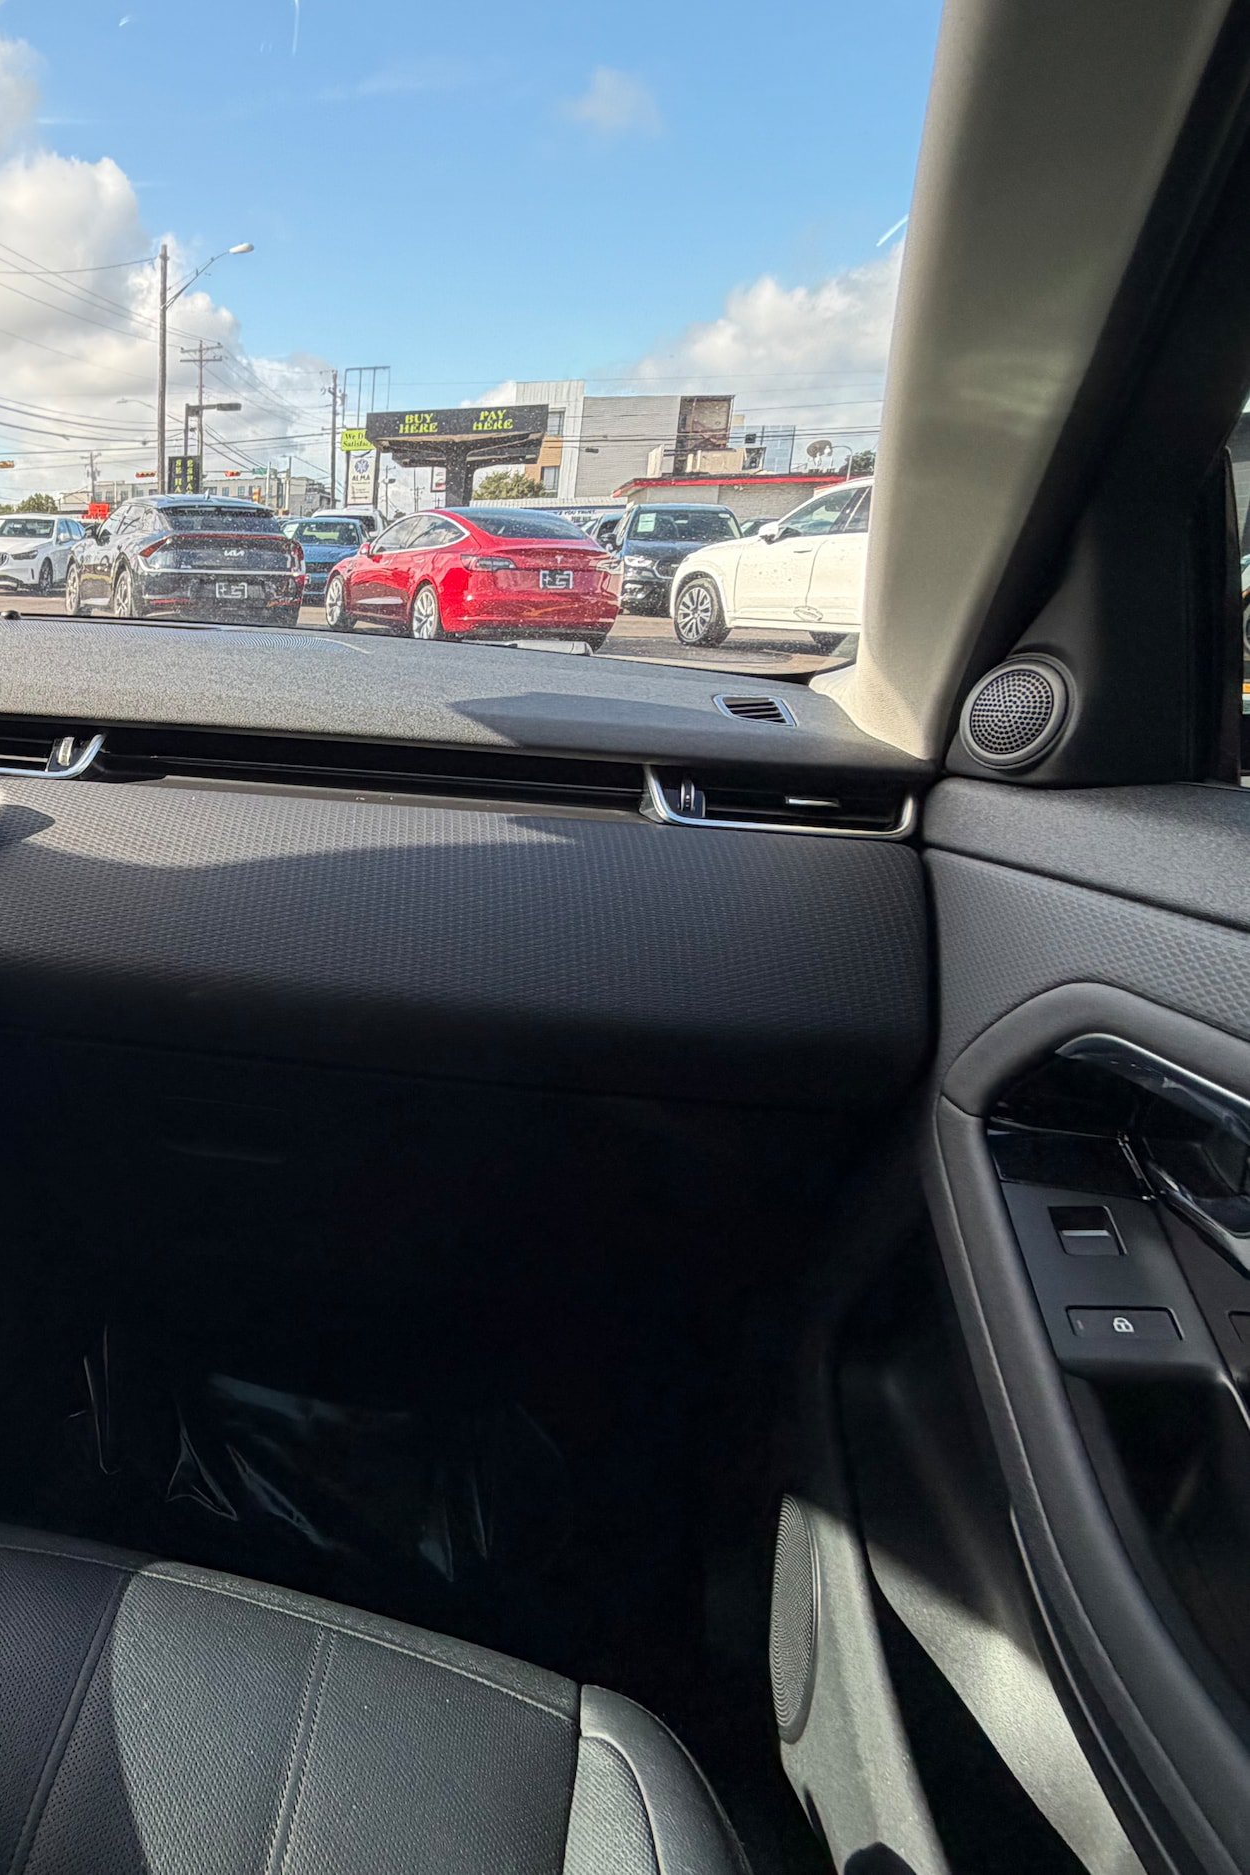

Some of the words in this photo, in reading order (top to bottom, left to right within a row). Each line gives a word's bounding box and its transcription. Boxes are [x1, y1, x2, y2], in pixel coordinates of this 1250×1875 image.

[405, 413, 434, 424] BUY
[480, 409, 506, 421] PAY
[399, 422, 438, 434] HERE
[473, 418, 513, 431] HERE
